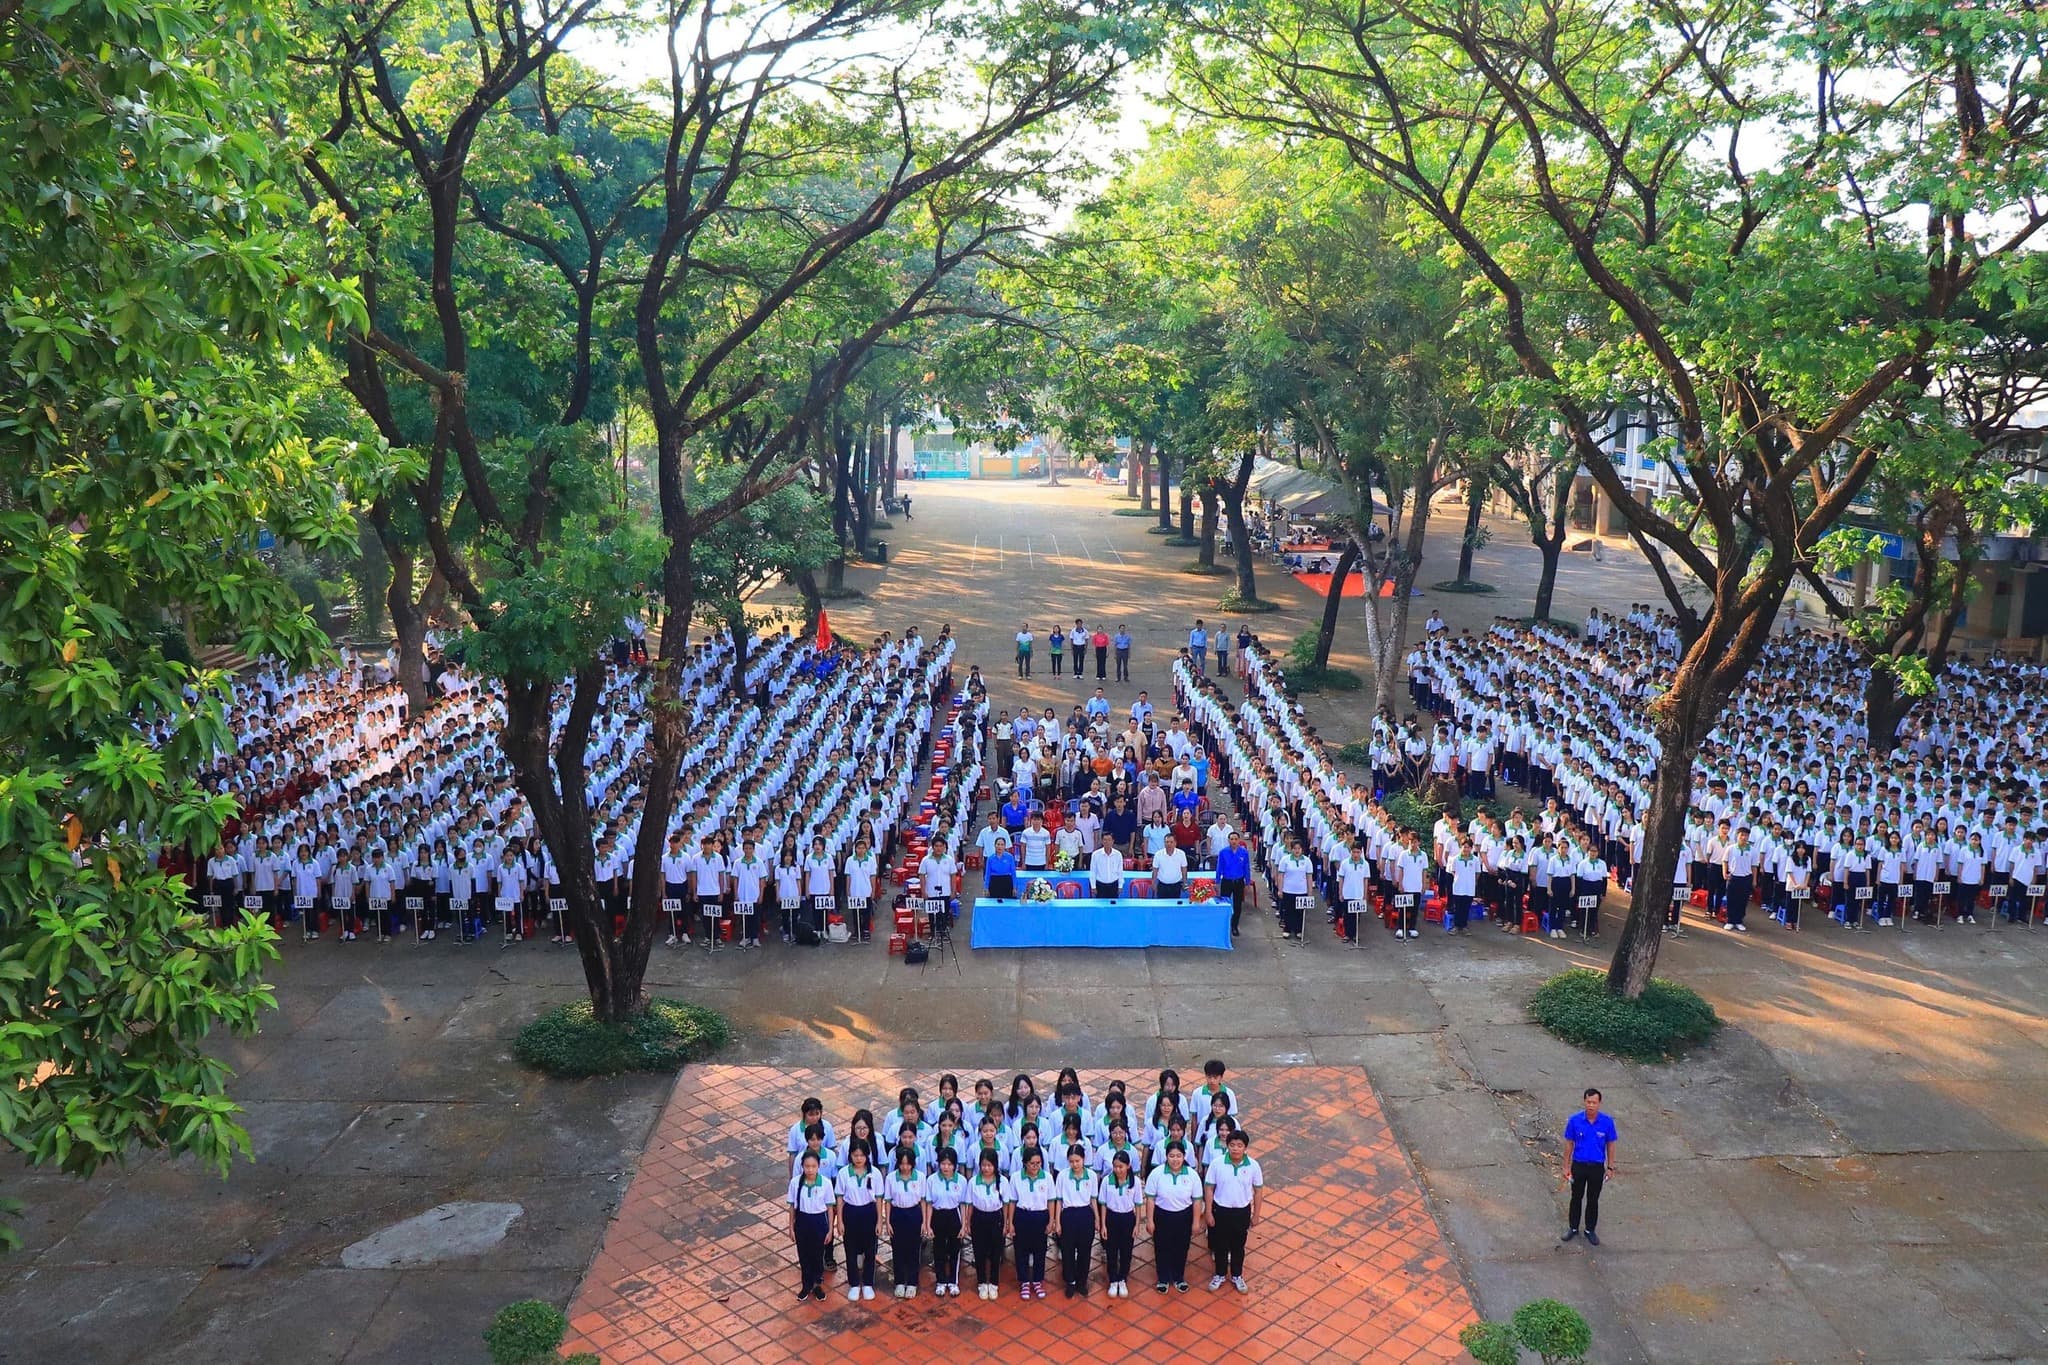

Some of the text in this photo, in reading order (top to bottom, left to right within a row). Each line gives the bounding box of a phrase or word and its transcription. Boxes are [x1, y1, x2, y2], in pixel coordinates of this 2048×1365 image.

[552, 899, 568, 909] 11A
[815, 897, 833, 907] 11A8
[849, 897, 865, 907] 11A9
[704, 905, 720, 915] 11A5
[735, 903, 752, 914] 11A6
